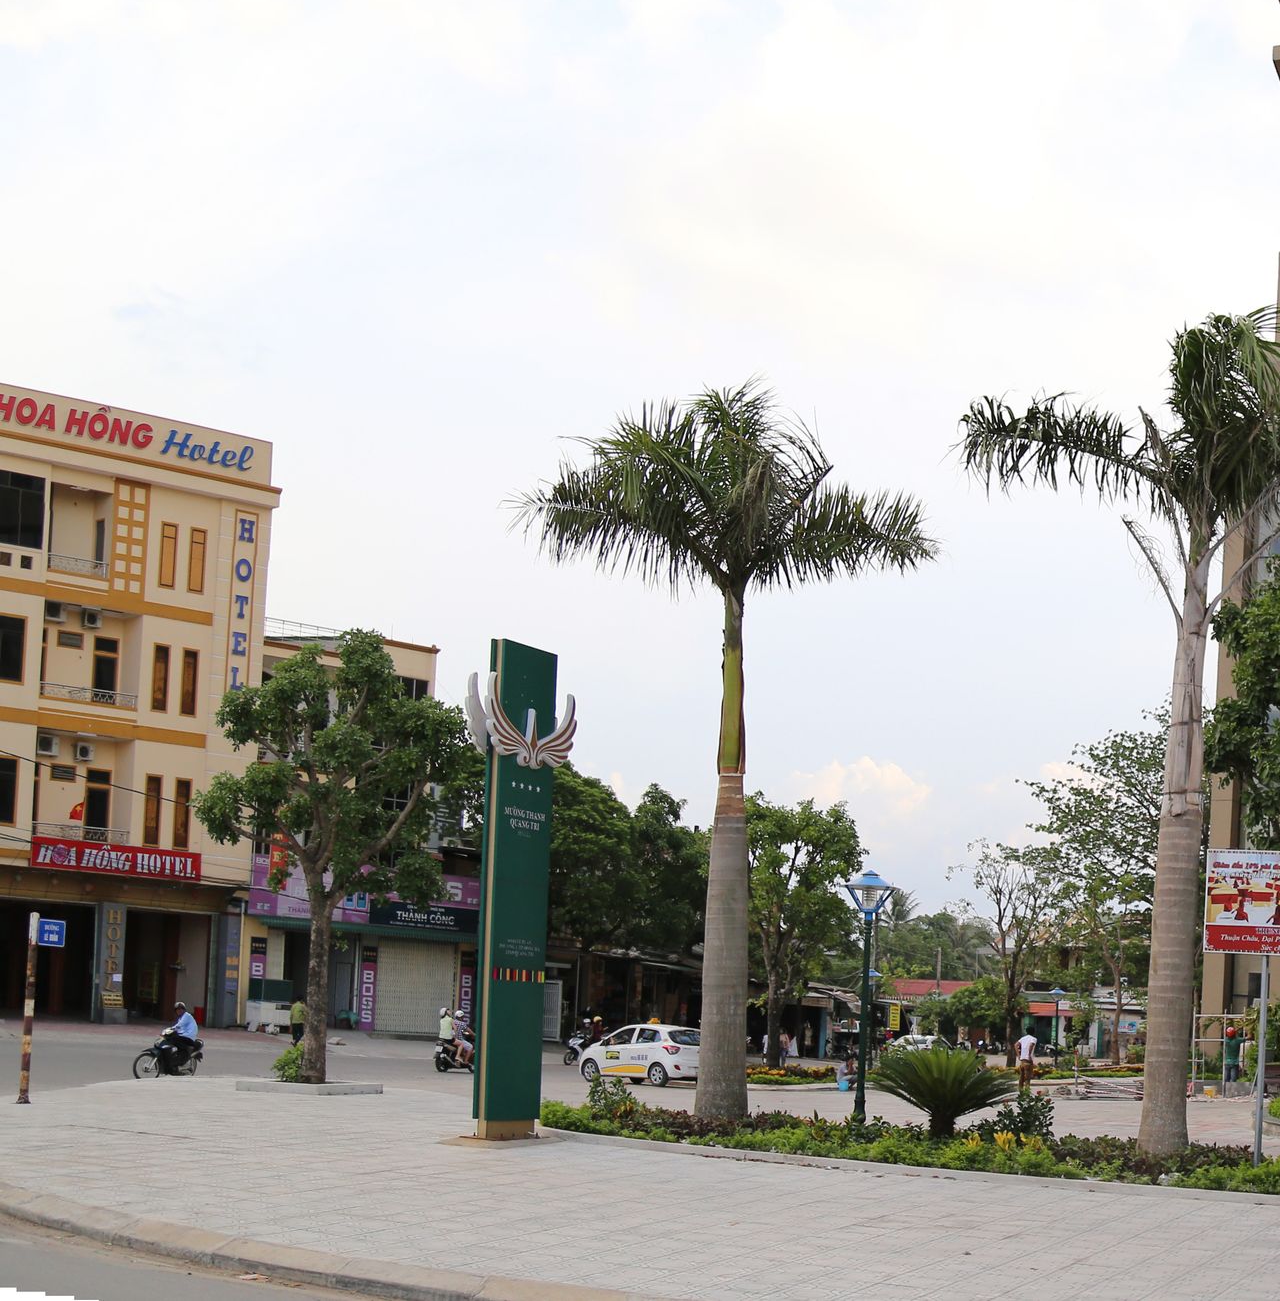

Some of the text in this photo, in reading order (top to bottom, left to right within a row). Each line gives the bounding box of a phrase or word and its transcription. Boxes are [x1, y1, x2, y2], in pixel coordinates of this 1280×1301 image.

[0, 394, 56, 431] HOA
[160, 429, 254, 472] Hotel
[230, 518, 255, 691] HOTEL
[510, 818, 540, 831] QUANG TRI
[525, 811, 546, 822] THANH
[136, 853, 196, 878] HOTEL
[430, 913, 455, 925] CÔNG
[104, 909, 122, 992] HOTEL
[361, 970, 374, 1023] BOSS
